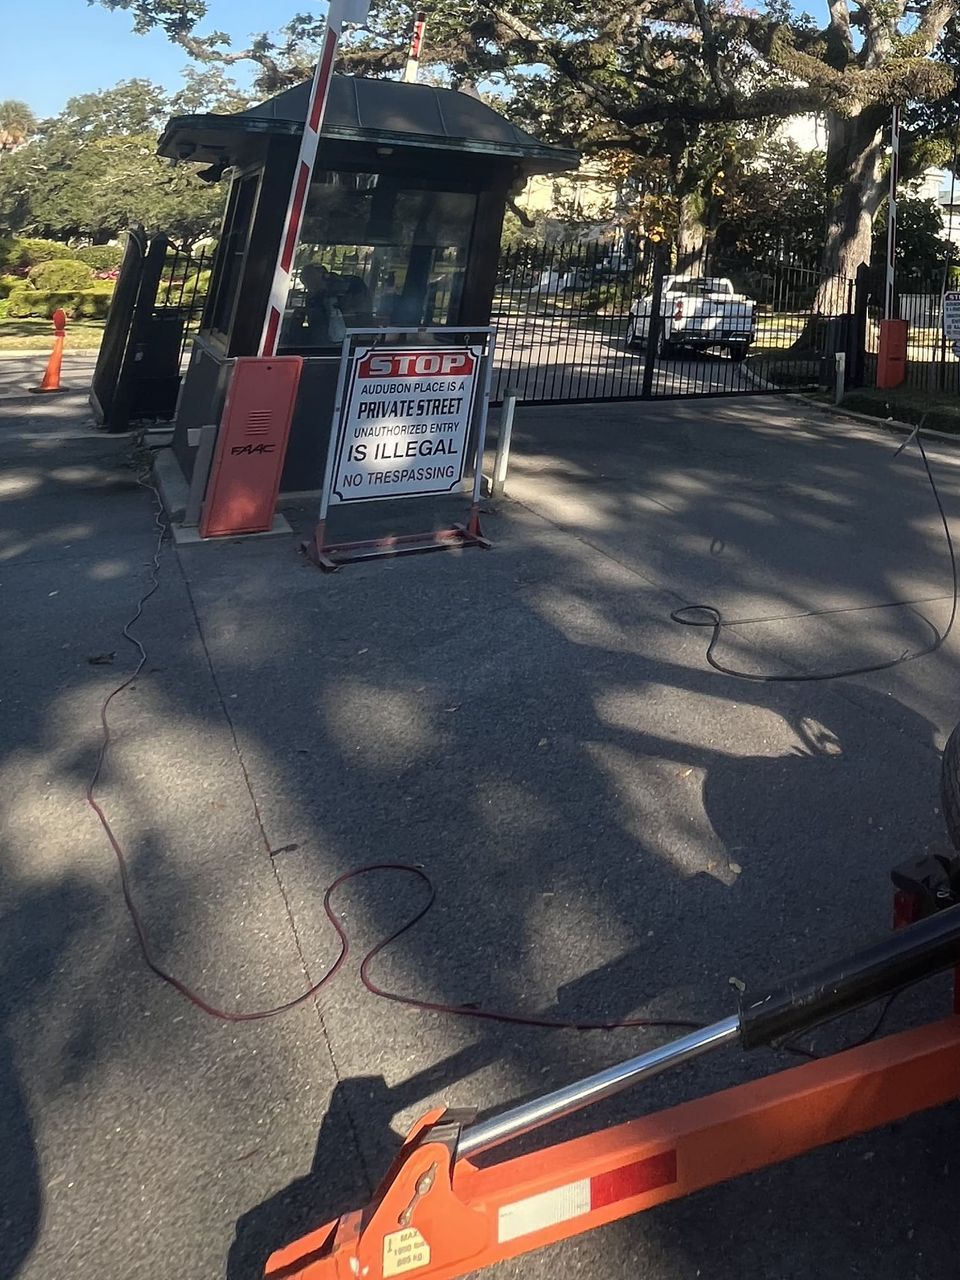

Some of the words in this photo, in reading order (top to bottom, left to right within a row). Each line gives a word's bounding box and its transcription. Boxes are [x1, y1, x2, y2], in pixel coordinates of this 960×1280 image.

[369, 355, 466, 375] STOP
[361, 383, 411, 395] AUDUBON
[413, 382, 445, 393] PLACE
[447, 382, 457, 392] IS
[458, 381, 465, 391] A
[357, 400, 415, 419] PRIVATE
[416, 398, 463, 416] STREET
[354, 423, 427, 439] UNAUTHORIZED
[429, 422, 460, 434] ENTRY
[230, 443, 276, 456] FAAC
[347, 444, 368, 462] IS
[374, 438, 458, 460] ILLEGAL
[342, 473, 363, 488] NO
[367, 465, 454, 485] TRESPASSING
